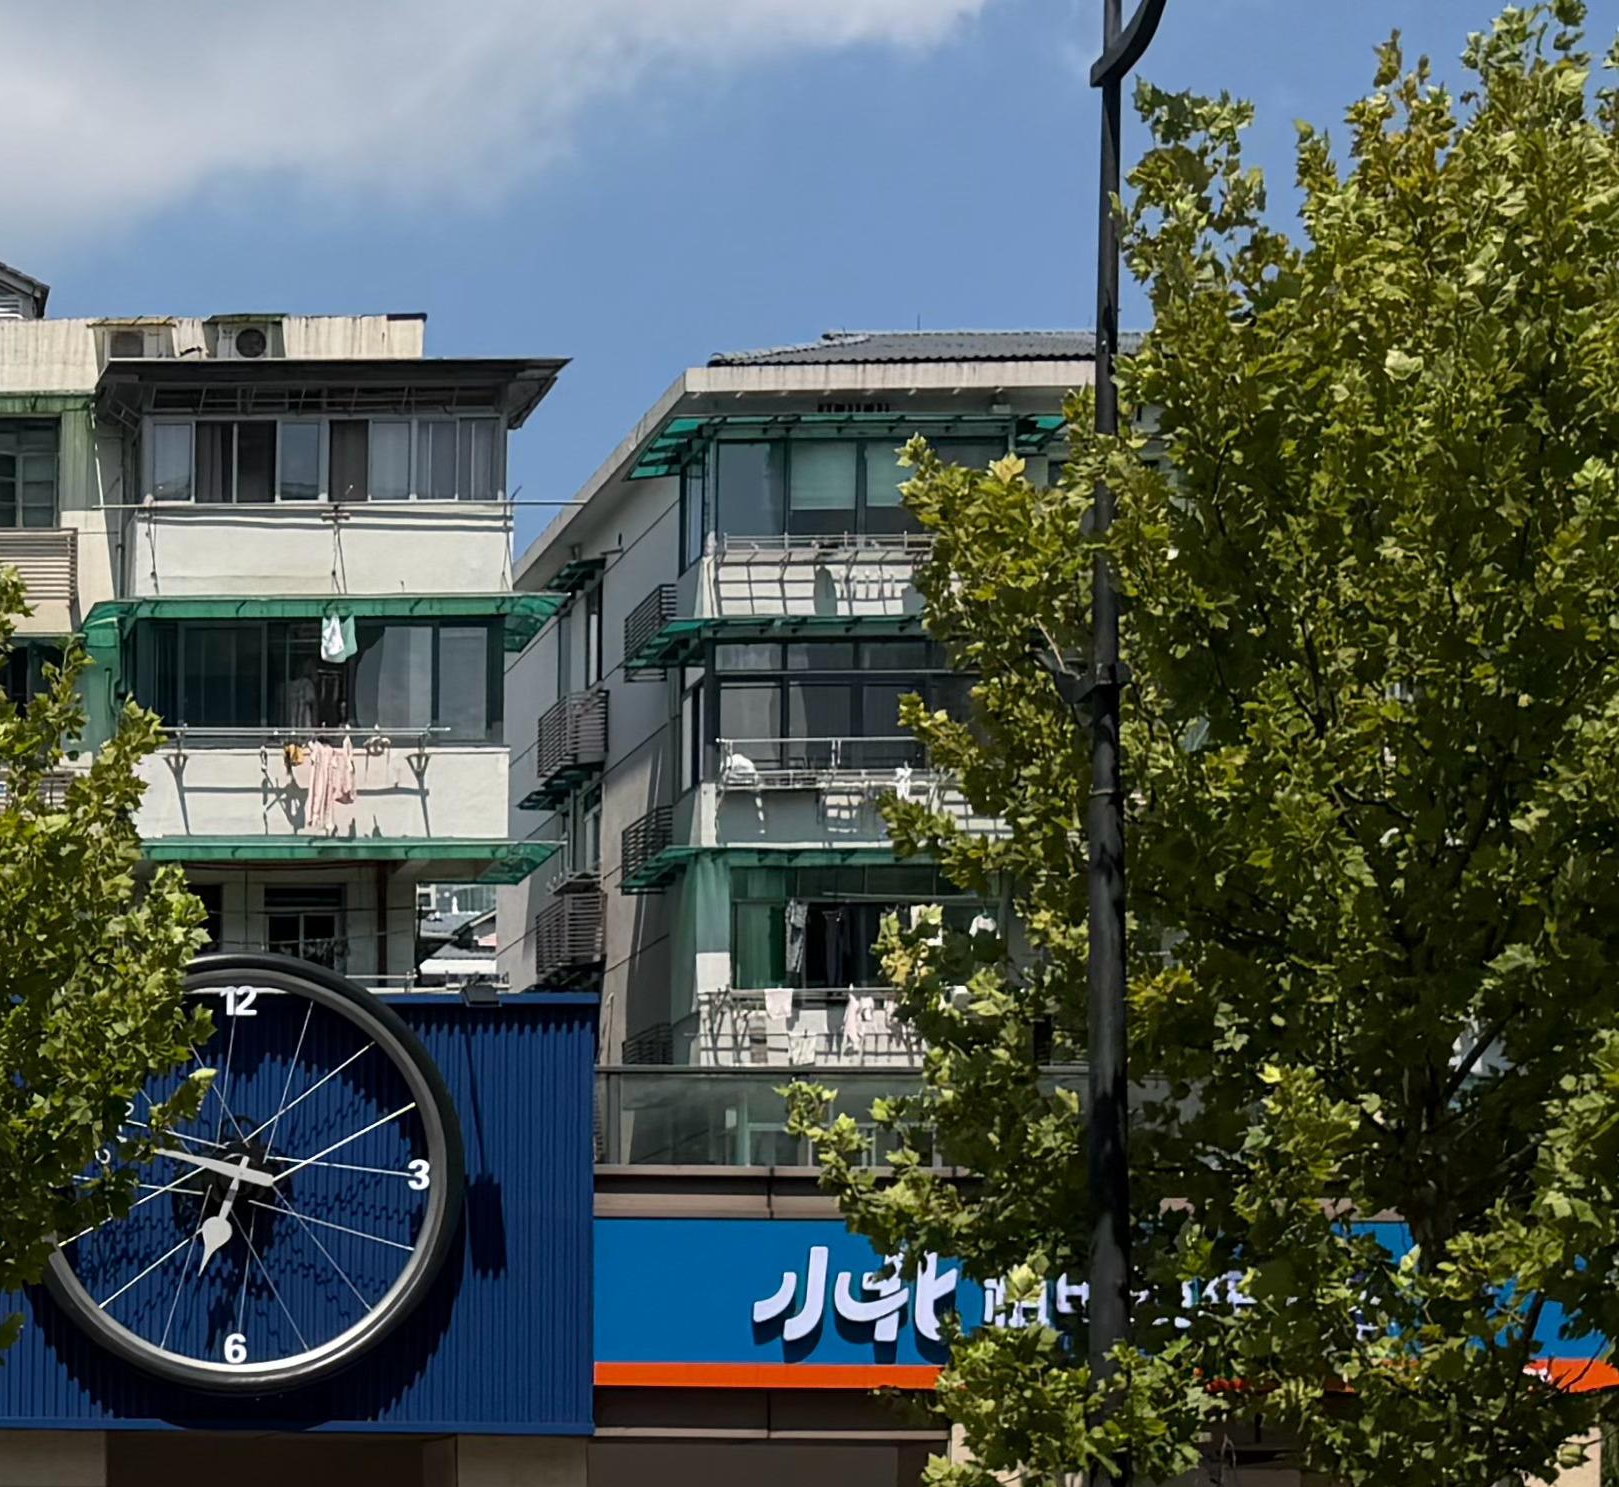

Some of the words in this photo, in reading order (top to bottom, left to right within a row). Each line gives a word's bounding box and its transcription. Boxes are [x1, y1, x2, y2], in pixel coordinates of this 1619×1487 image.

[220, 986, 257, 1015] 12
[407, 1159, 430, 1190] 3
[223, 1333, 248, 1364] 6
